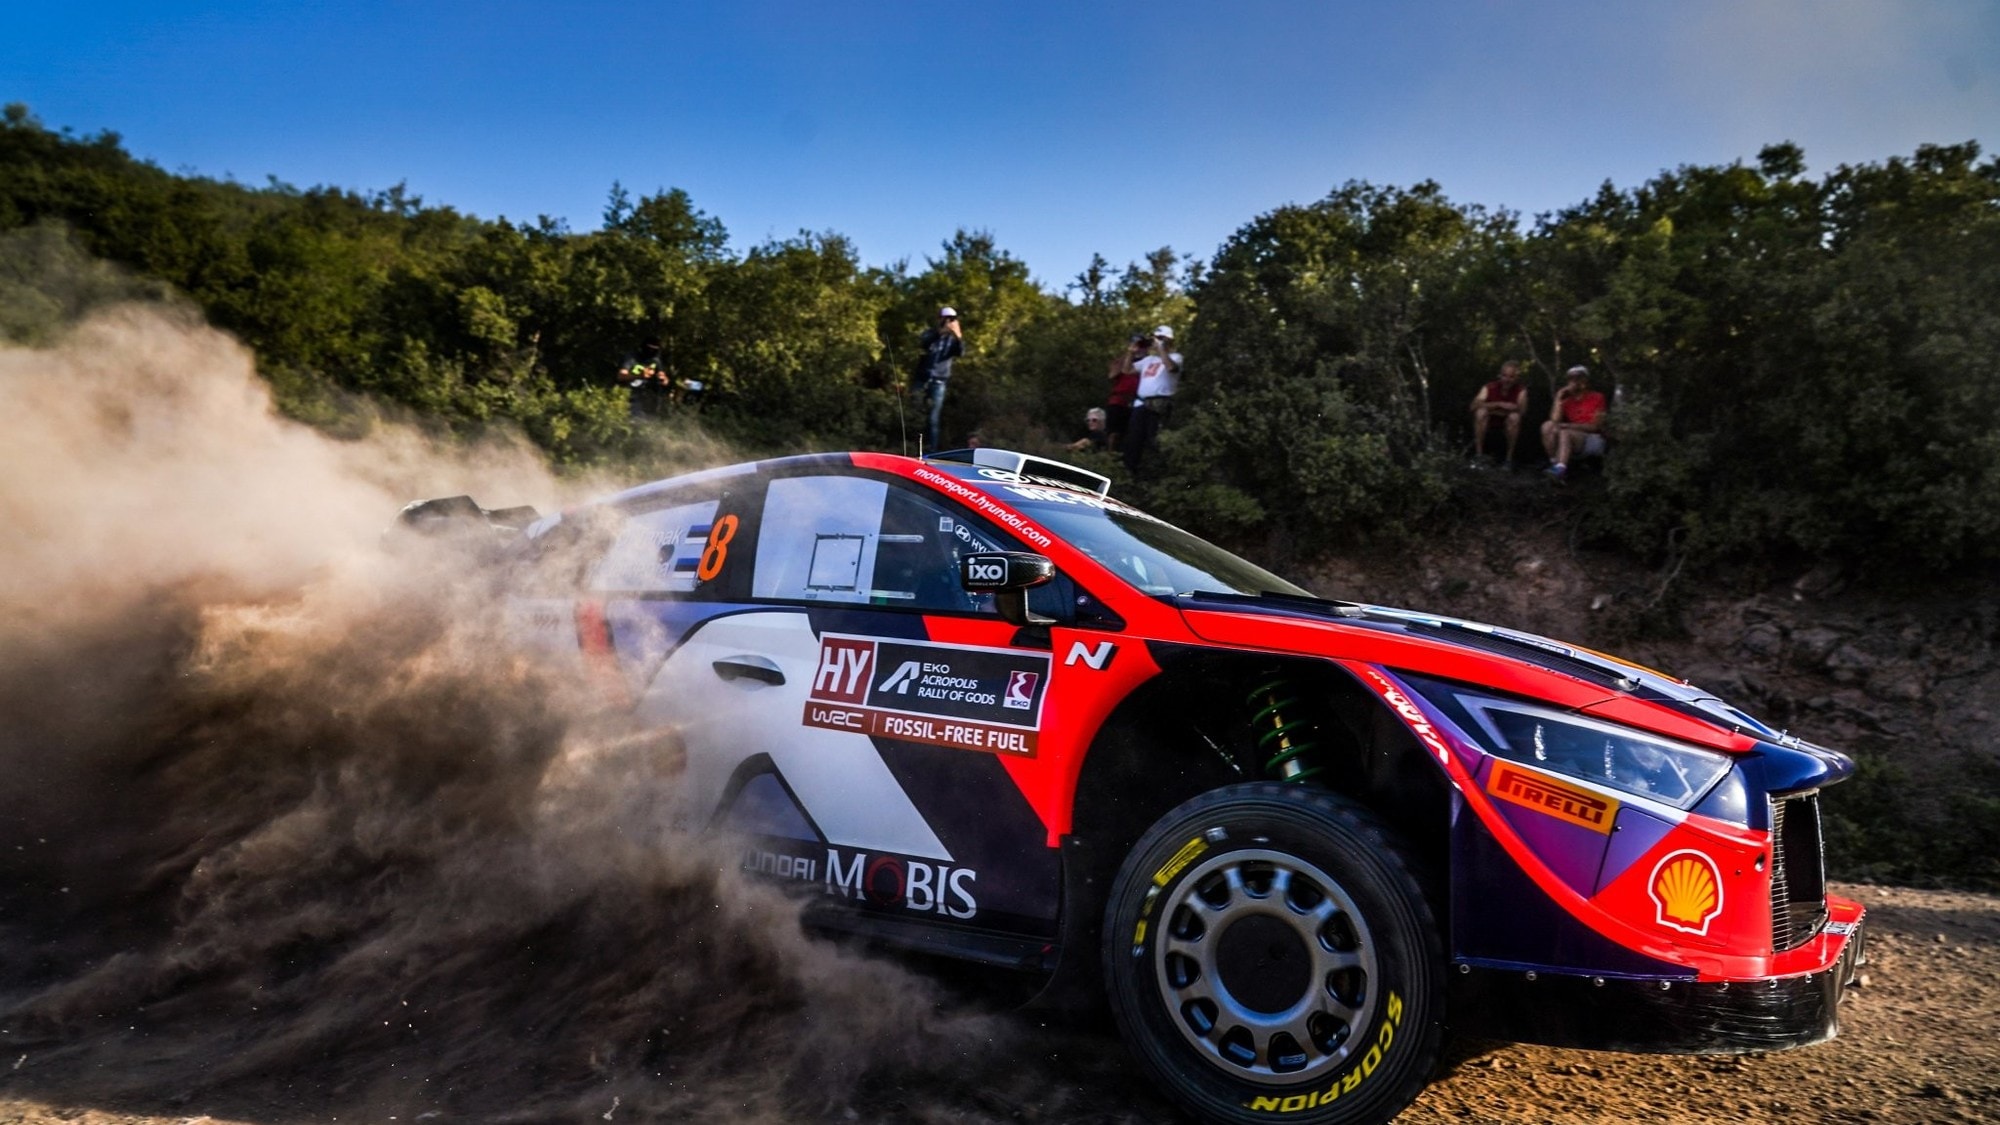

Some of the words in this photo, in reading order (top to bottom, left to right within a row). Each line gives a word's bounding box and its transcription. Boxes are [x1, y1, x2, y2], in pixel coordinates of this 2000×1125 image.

[914, 467, 1051, 548] motorsport.hyundai.com
[698, 514, 740, 581] 8
[815, 646, 870, 694] HY
[923, 662, 950, 673] EKO
[1064, 641, 1115, 671] N
[918, 686, 948, 700] RALLY
[949, 690, 965, 701] OF
[965, 692, 995, 705] GODS
[921, 675, 978, 689] ACROPOLIS
[812, 707, 864, 728] WRC
[1010, 699, 1029, 708] EKO
[884, 717, 983, 746] FOSSIL-FREE
[987, 731, 1029, 752] FUEL
[1497, 769, 1608, 825] PIRELLI
[825, 848, 977, 919] MOBIS
[1250, 991, 1403, 1113] SCORPION
